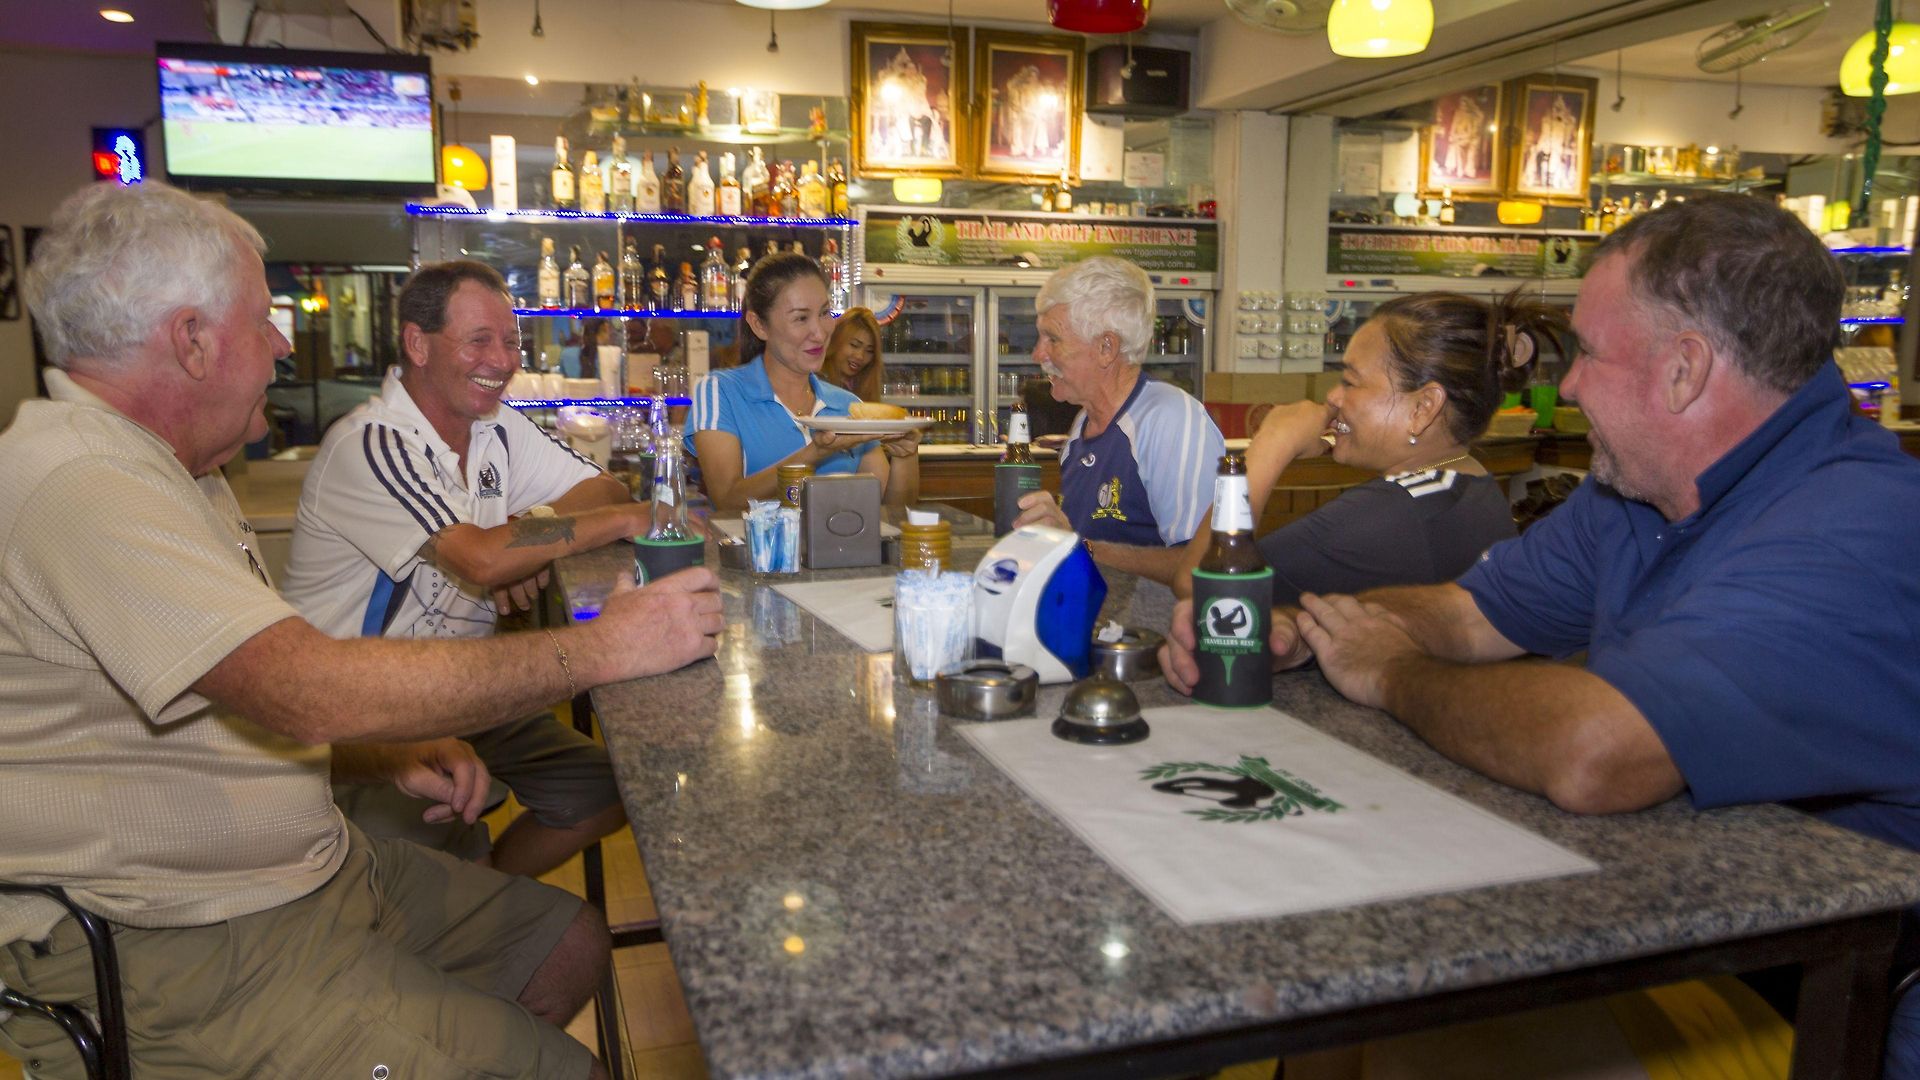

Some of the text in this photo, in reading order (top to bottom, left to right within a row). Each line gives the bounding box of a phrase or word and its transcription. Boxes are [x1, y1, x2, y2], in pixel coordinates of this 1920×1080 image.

[955, 219, 1197, 246] THAILAND GOLF EXPERIENCE
[1203, 638, 1238, 646] TRAVELLERS
